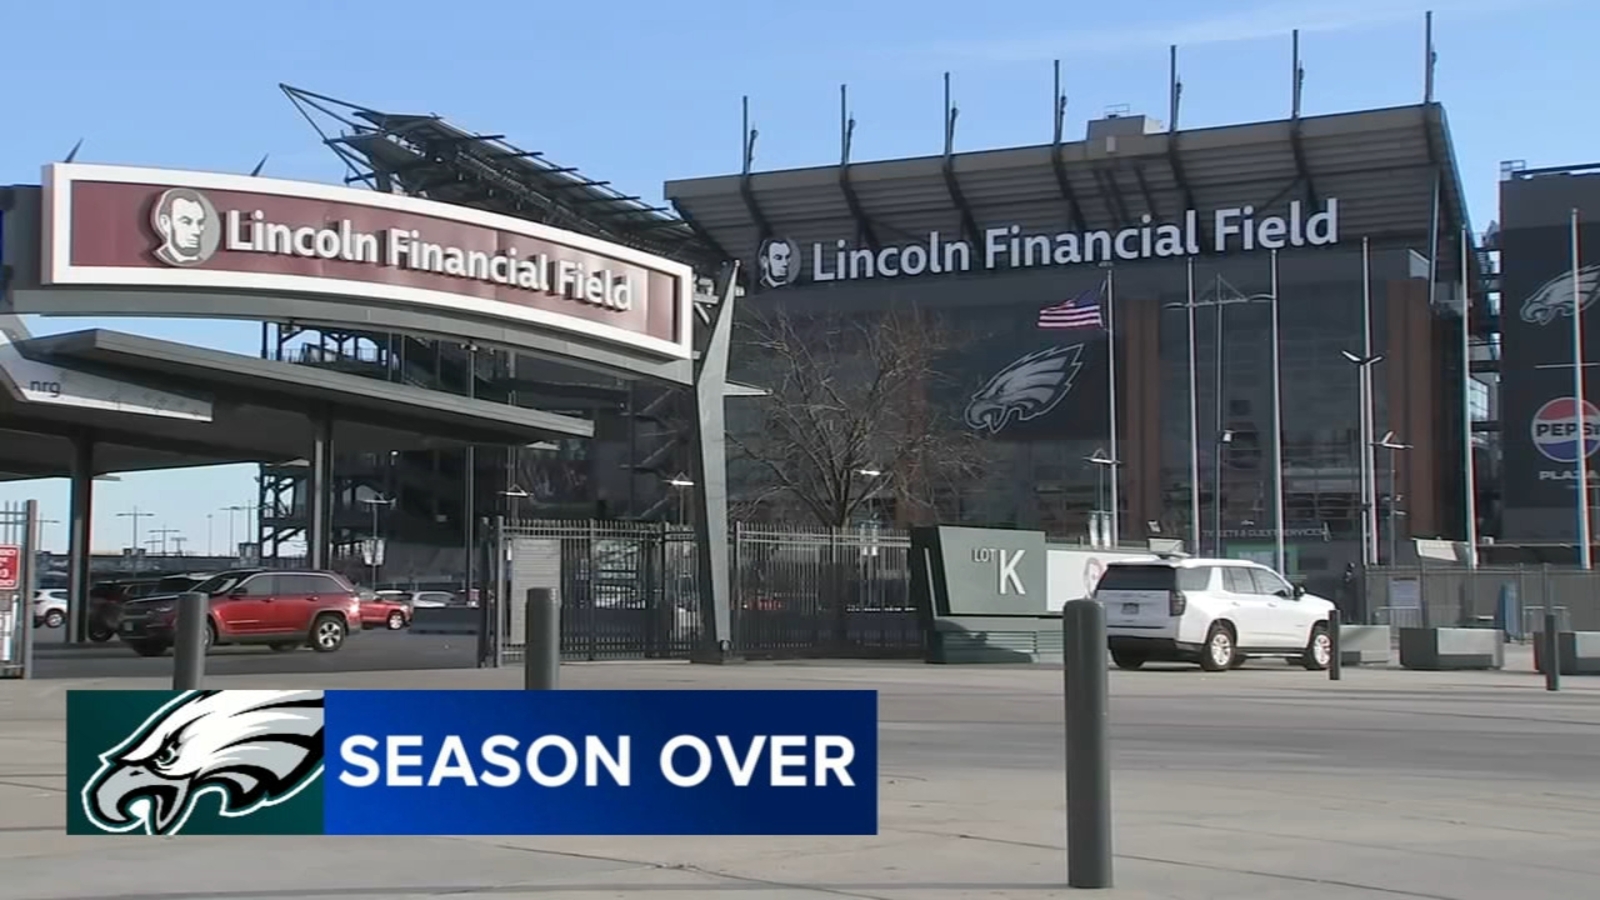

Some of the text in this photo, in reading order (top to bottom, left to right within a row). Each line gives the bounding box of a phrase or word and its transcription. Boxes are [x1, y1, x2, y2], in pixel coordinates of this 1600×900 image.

[226, 209, 632, 312] Lincoln Financial Field
[813, 198, 1337, 281] Lincoln Financial Field
[29, 379, 61, 398] nrg
[1536, 422, 1600, 437] PEPSI
[973, 548, 1026, 595] LOT K
